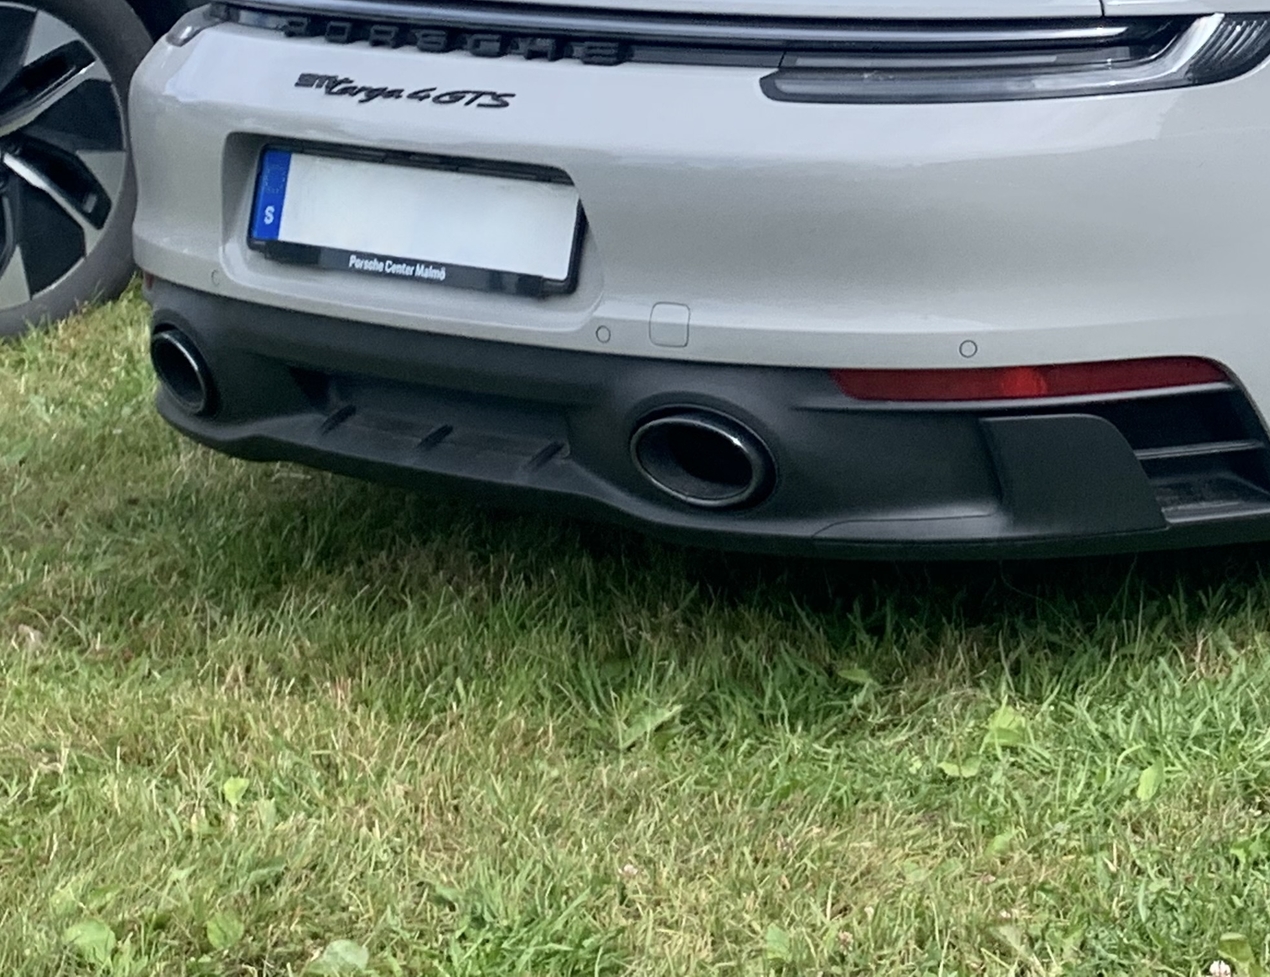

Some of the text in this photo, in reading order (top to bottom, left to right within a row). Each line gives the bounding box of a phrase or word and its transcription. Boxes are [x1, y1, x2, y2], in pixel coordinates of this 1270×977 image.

[282, 17, 623, 66] PORSCHE
[406, 87, 437, 102] 4
[432, 89, 516, 109] GTS
[263, 205, 276, 225] S
[348, 254, 446, 281] Porsche Center Malmö
